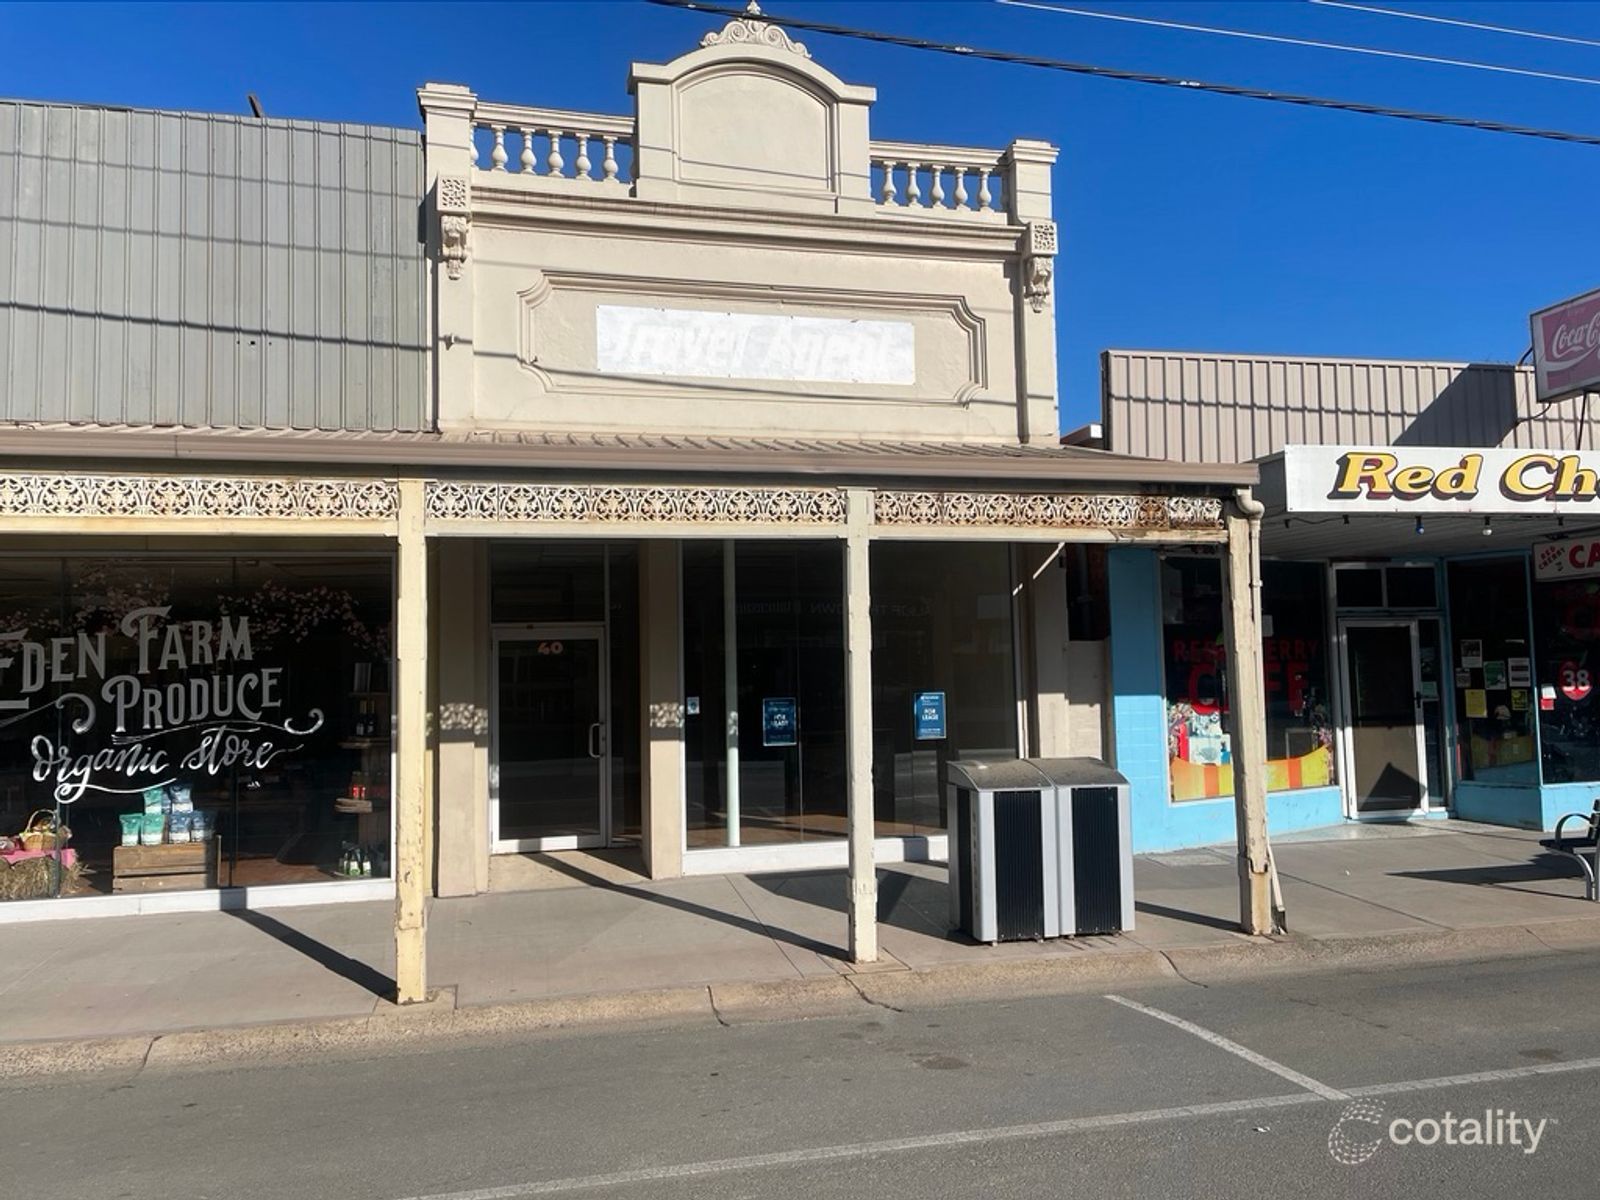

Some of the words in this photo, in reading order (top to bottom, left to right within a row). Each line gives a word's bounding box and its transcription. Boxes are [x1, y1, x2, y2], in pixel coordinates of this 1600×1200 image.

[1327, 451, 1484, 502] Red
[121, 605, 253, 675] FARM
[536, 640, 564, 655] 40
[101, 667, 283, 733] PRODUCE
[1562, 669, 1590, 692] 38
